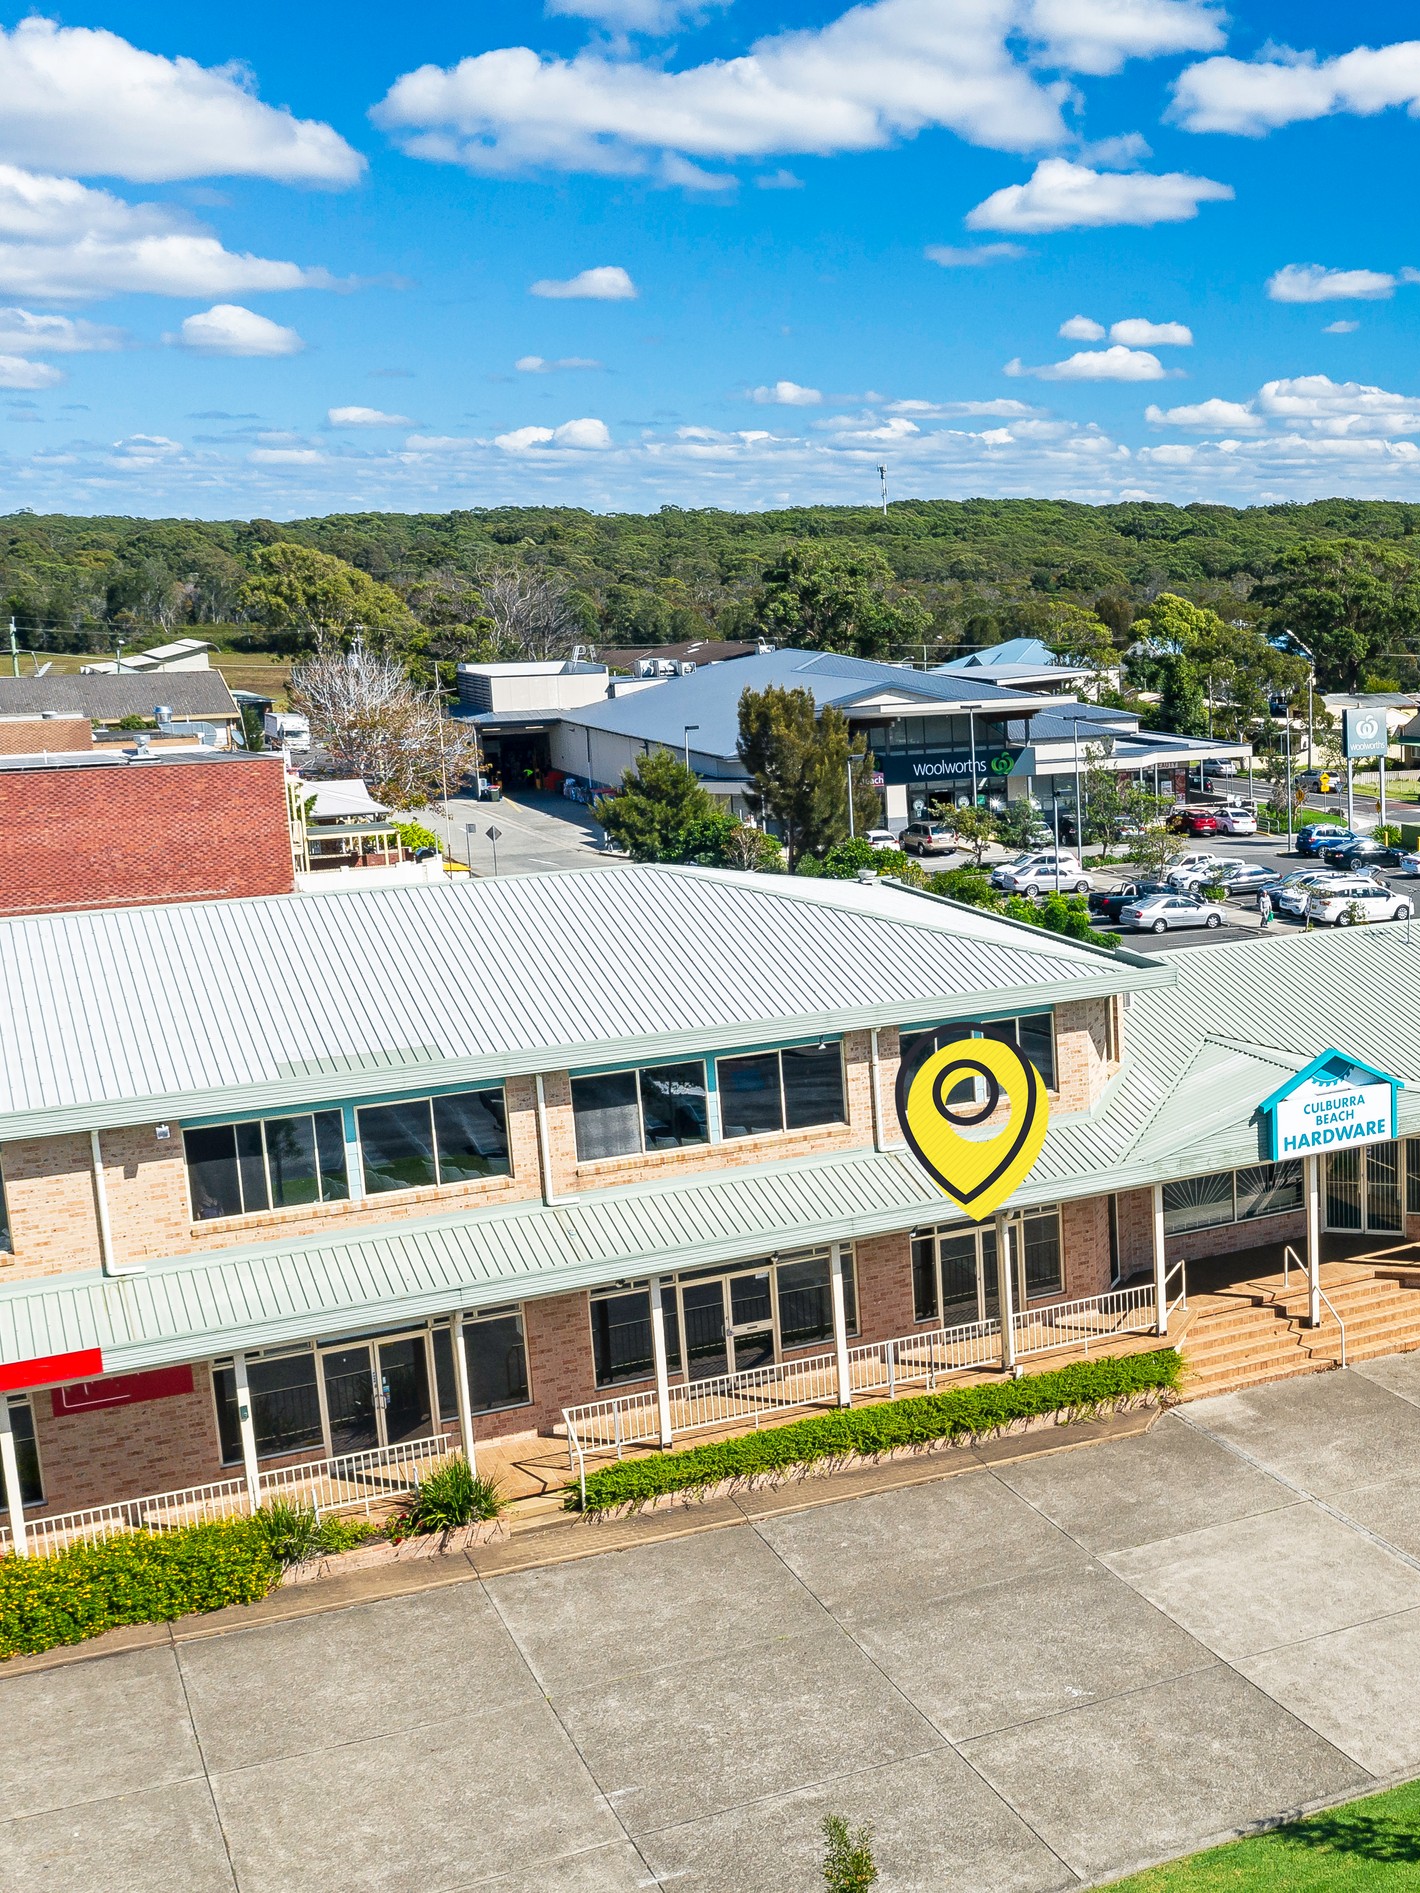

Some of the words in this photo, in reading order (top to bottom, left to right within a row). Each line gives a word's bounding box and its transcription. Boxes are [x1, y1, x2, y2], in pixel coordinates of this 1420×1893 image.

[1304, 1094, 1365, 1115] CULBURRA
[1316, 1109, 1354, 1126] BEACH
[1284, 1119, 1386, 1151] HARDWARE
